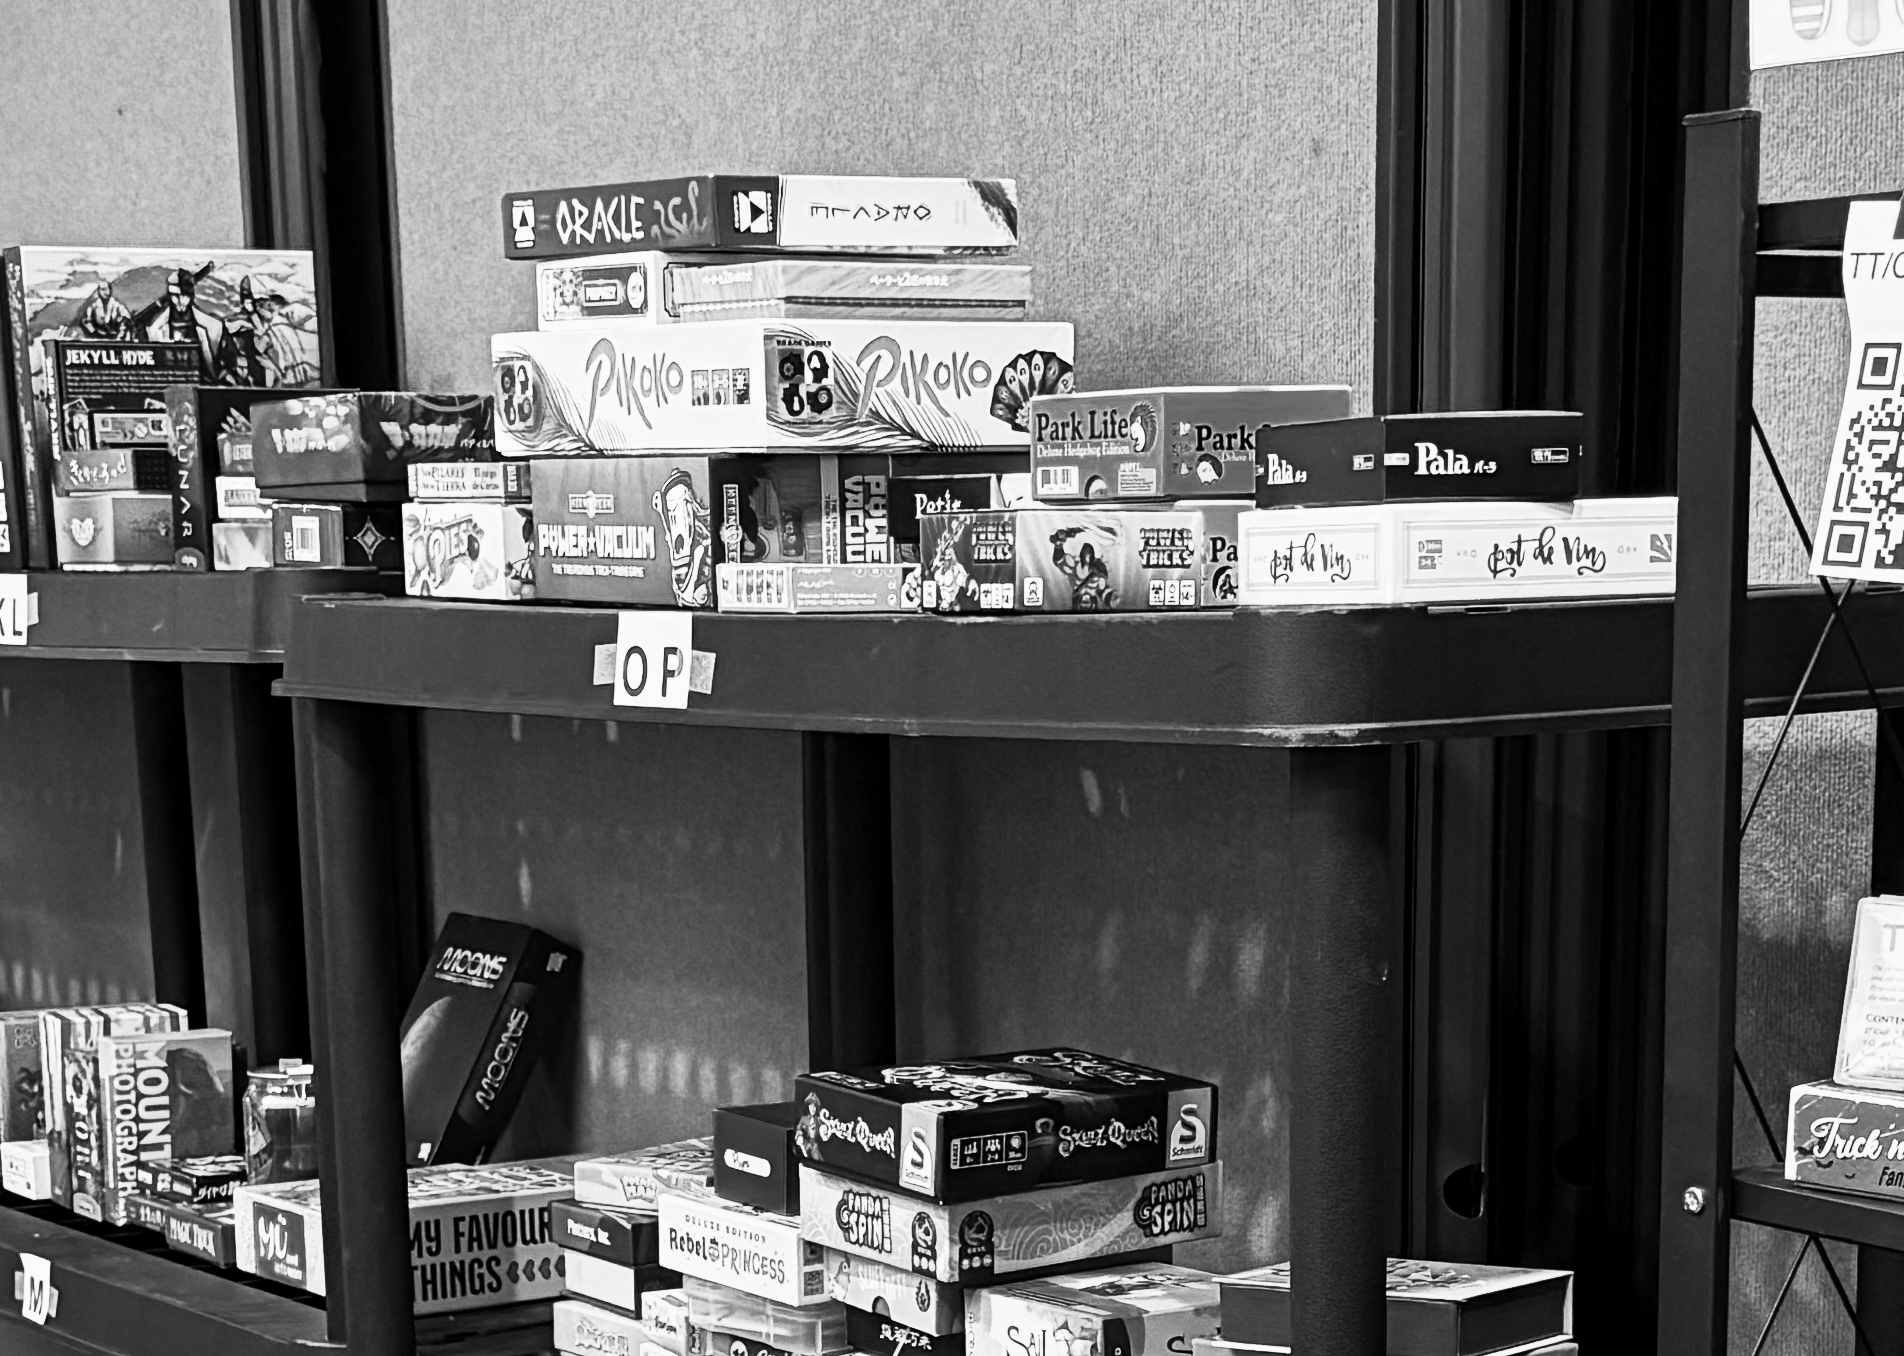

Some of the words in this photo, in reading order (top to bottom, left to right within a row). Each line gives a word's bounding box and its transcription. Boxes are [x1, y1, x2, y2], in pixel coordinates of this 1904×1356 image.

[556, 194, 645, 249] ORACLE
[65, 349, 120, 367] JEKYLL
[121, 349, 156, 367] HYDE
[1036, 412, 1083, 442] Park
[1088, 408, 1129, 440] Life
[1195, 424, 1254, 452] Park
[1266, 453, 1295, 486] Pala
[1414, 441, 1471, 477] Pala
[436, 946, 508, 981] MOONS
[1810, 1116, 1884, 1161] Trick
[1150, 1177, 1194, 1204] PANDA
[669, 1226, 708, 1262] Rebel
[720, 1240, 786, 1285] PRINCESS
[28, 1275, 45, 1316] M
